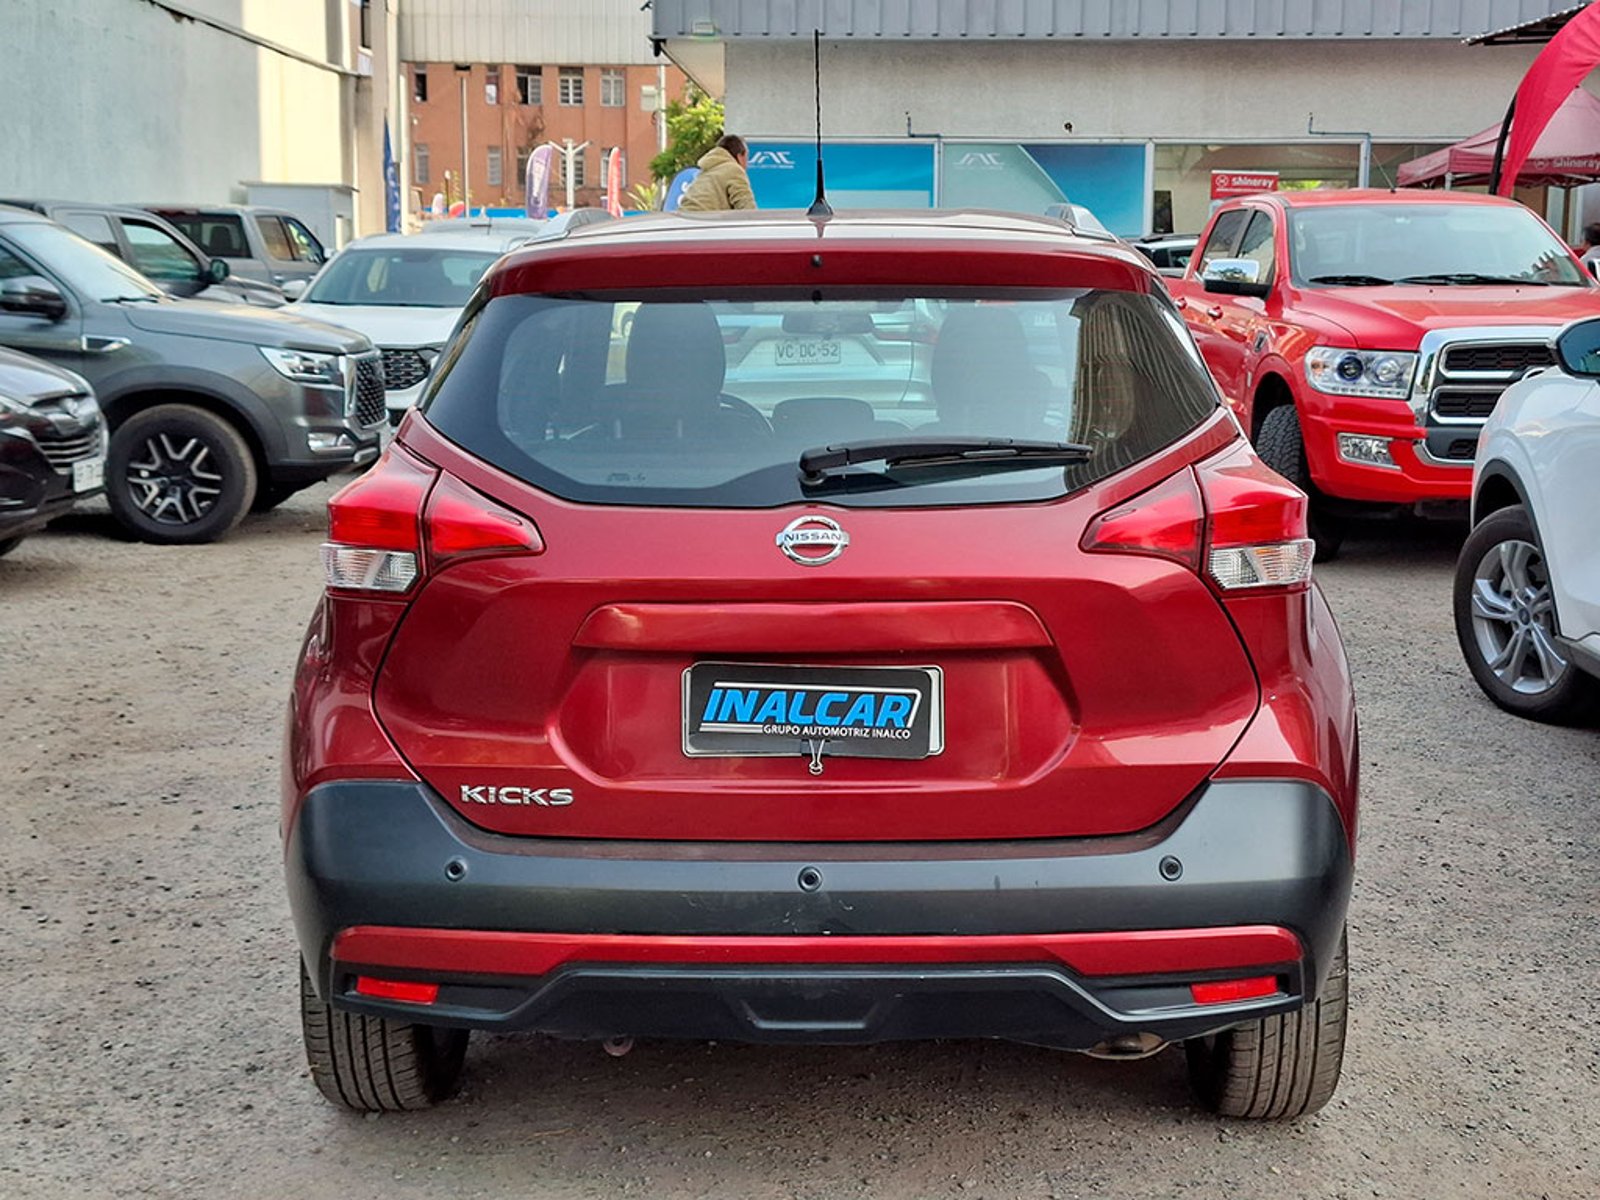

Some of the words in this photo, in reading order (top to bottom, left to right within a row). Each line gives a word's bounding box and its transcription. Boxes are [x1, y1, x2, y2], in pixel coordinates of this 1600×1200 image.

[783, 532, 842, 541] NISSAN
[702, 689, 912, 728] INALCAR
[763, 724, 800, 735] GRUPO
[802, 726, 869, 738] AUTOMOTRIZ
[872, 729, 911, 739] INALCO
[460, 784, 574, 806] KICKS
